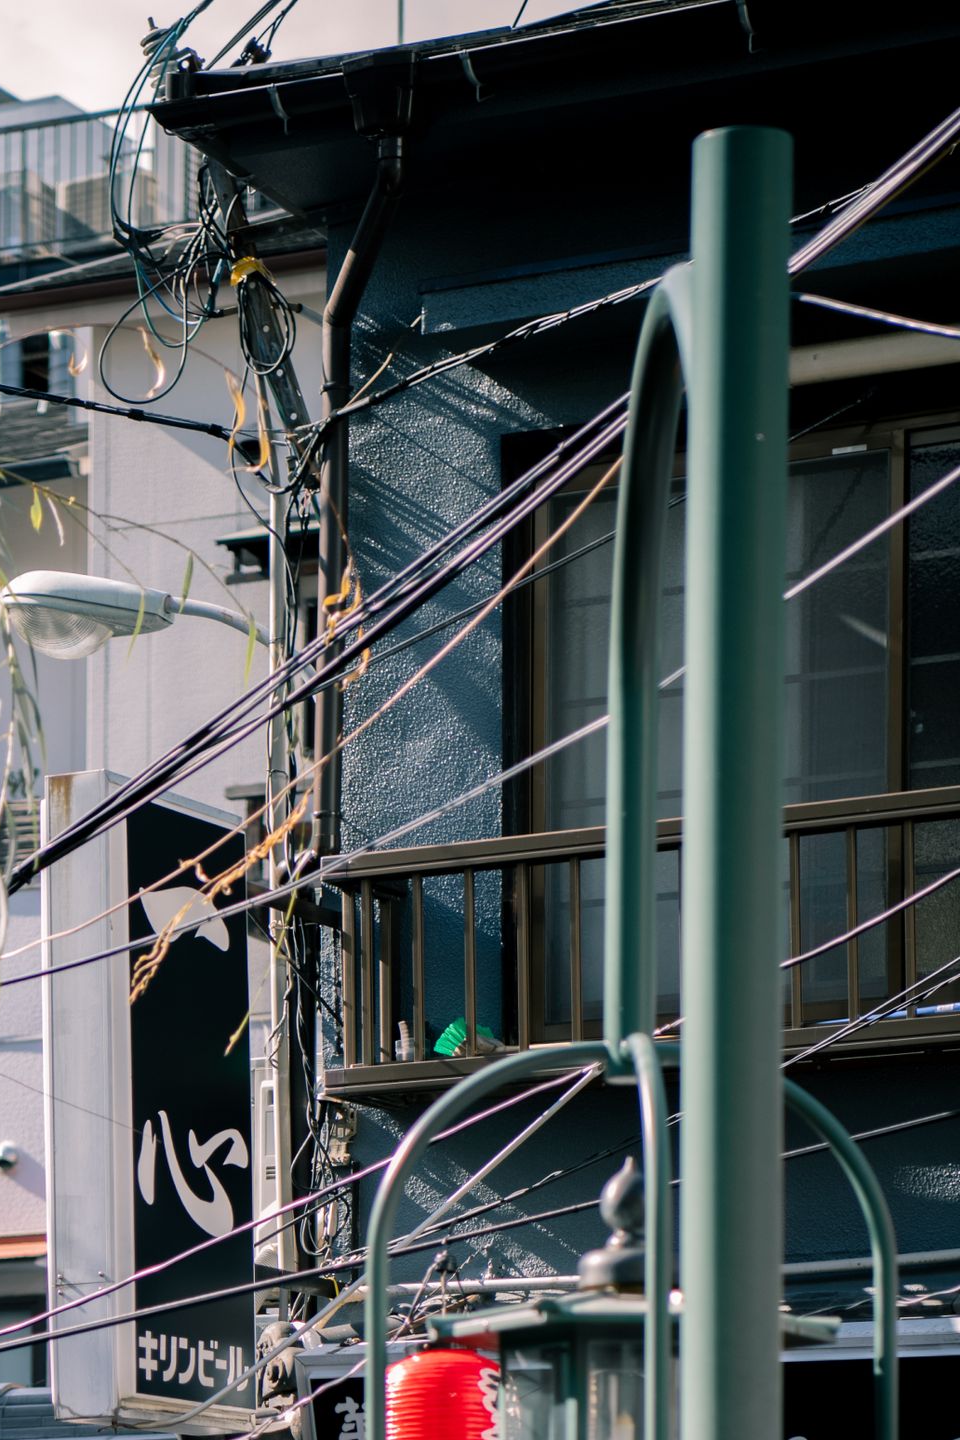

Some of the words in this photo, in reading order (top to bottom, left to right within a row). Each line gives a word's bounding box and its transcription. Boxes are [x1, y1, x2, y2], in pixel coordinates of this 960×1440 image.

[138, 1329, 249, 1392] キリンビール
